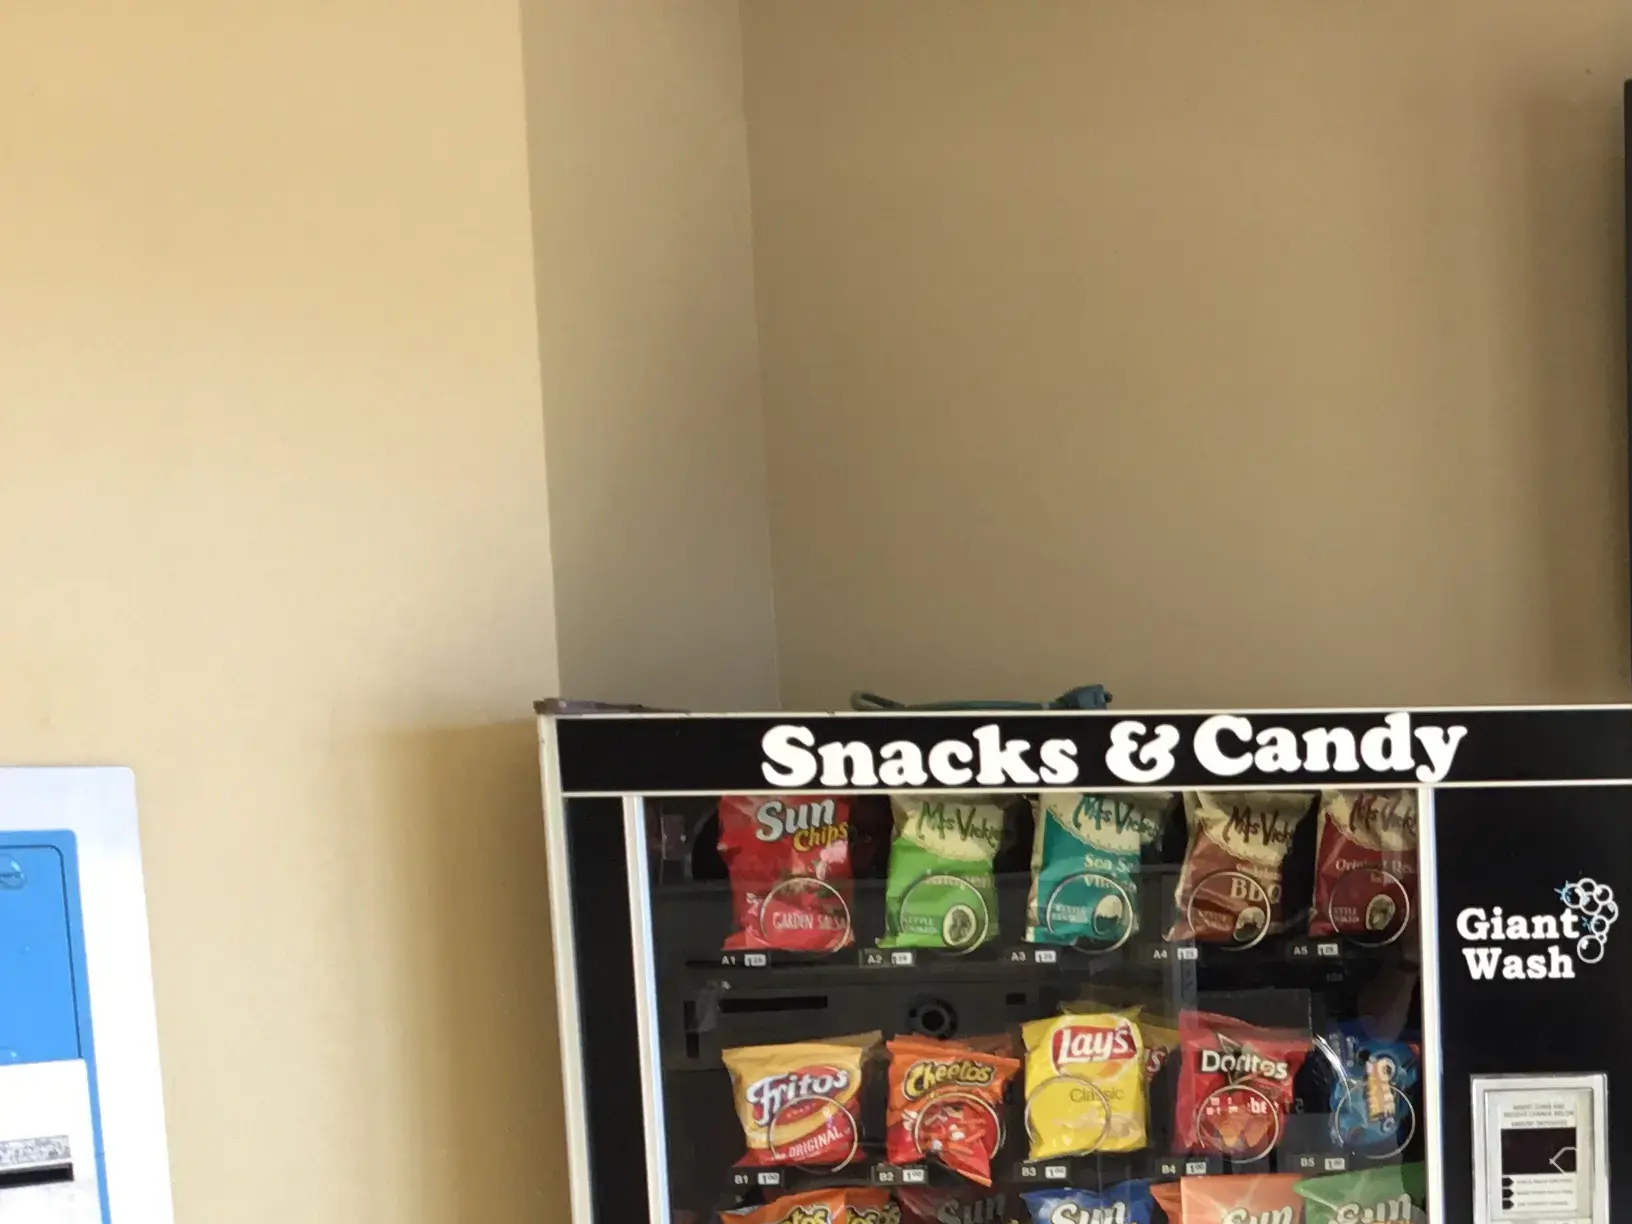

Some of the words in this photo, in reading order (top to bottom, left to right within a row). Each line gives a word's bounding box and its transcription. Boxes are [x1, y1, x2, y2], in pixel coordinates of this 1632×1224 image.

[761, 723, 1080, 787] Snacks
[1104, 720, 1180, 783] &
[1193, 712, 1468, 782] Candy
[755, 799, 835, 842] Sun
[794, 822, 849, 851] Chips
[1456, 906, 1580, 940] Giant
[1153, 949, 1168, 959] A4
[1293, 946, 1308, 956] A5
[1461, 945, 1576, 980] Wash
[1057, 1024, 1134, 1064] Lay's
[904, 1060, 994, 1099] Cheetos
[1200, 1049, 1288, 1080] Doritos
[747, 1068, 850, 1126] Fritos
[1069, 1085, 1124, 1103] Classic
[788, 1126, 843, 1158] ORIGINAL
[1161, 1164, 1176, 1174] B4
